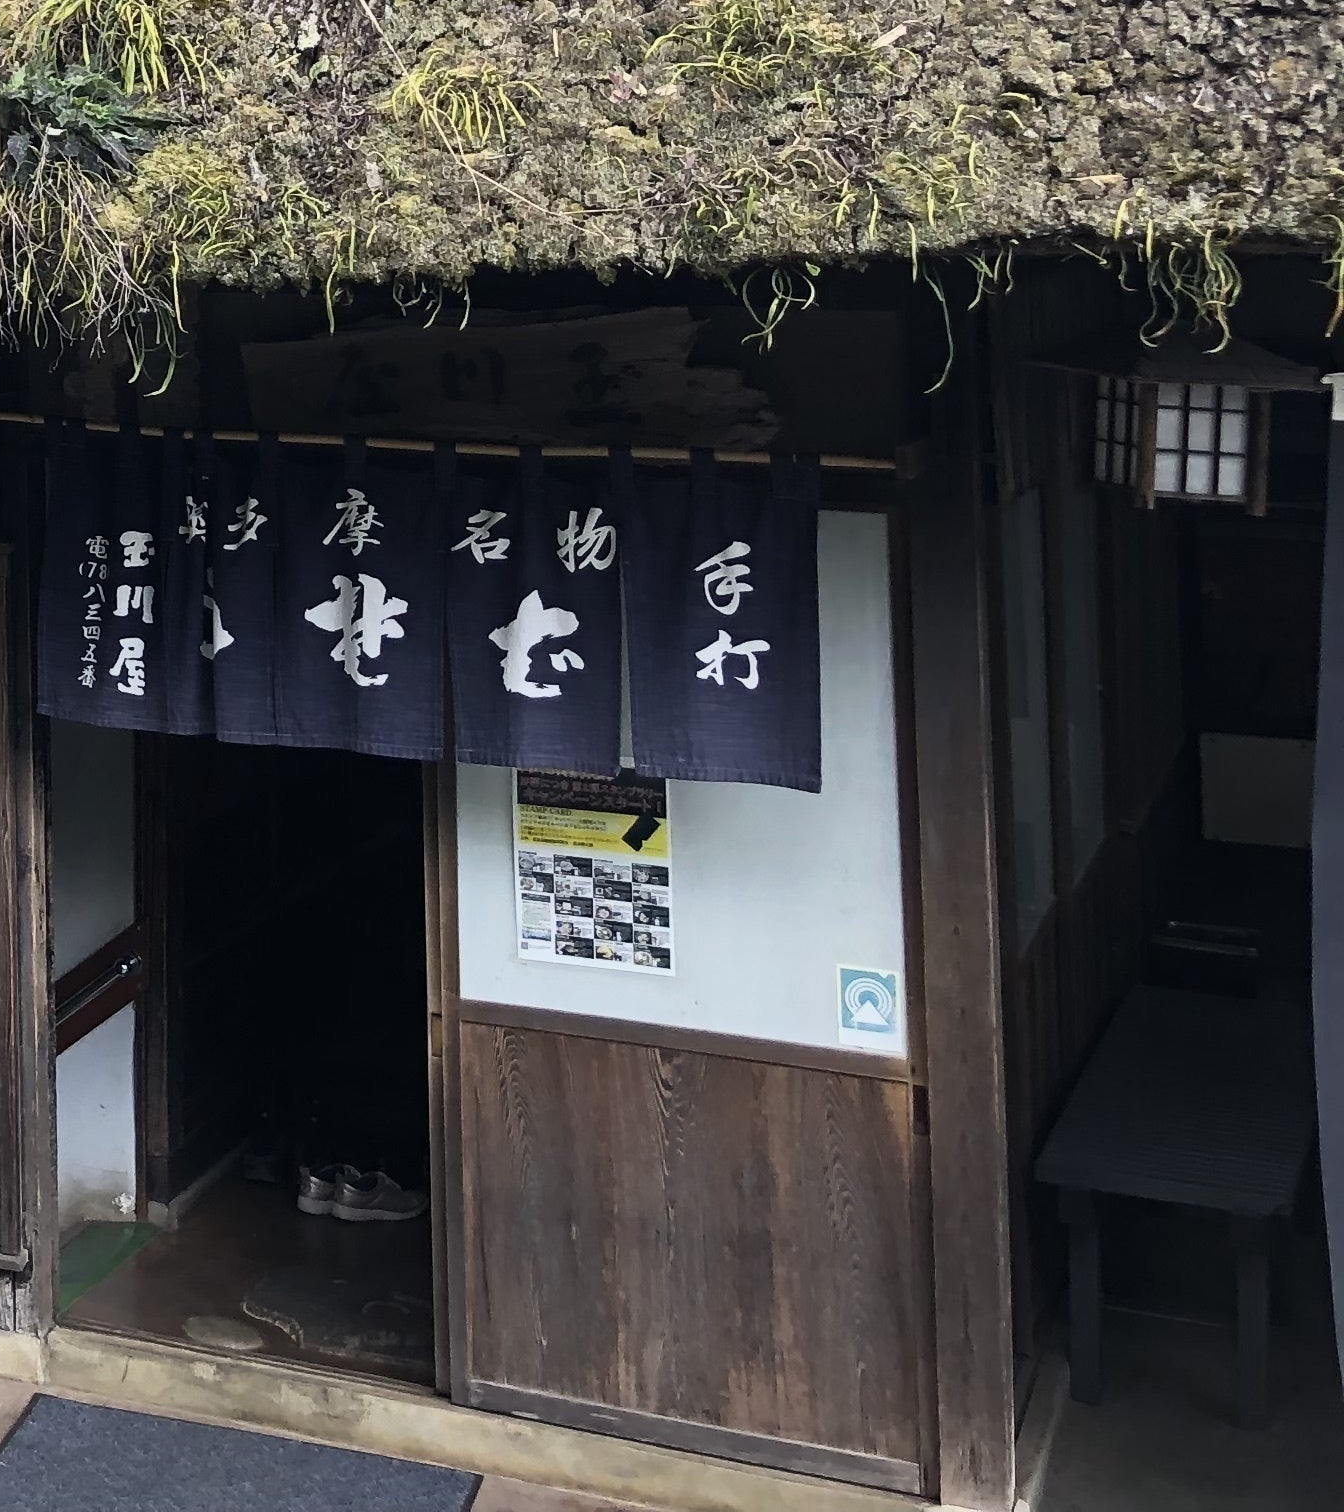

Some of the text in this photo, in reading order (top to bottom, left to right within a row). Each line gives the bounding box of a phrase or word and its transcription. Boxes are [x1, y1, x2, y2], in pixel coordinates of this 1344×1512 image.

[109, 531, 156, 696] 玉川屋
[693, 541, 771, 690] 手打
